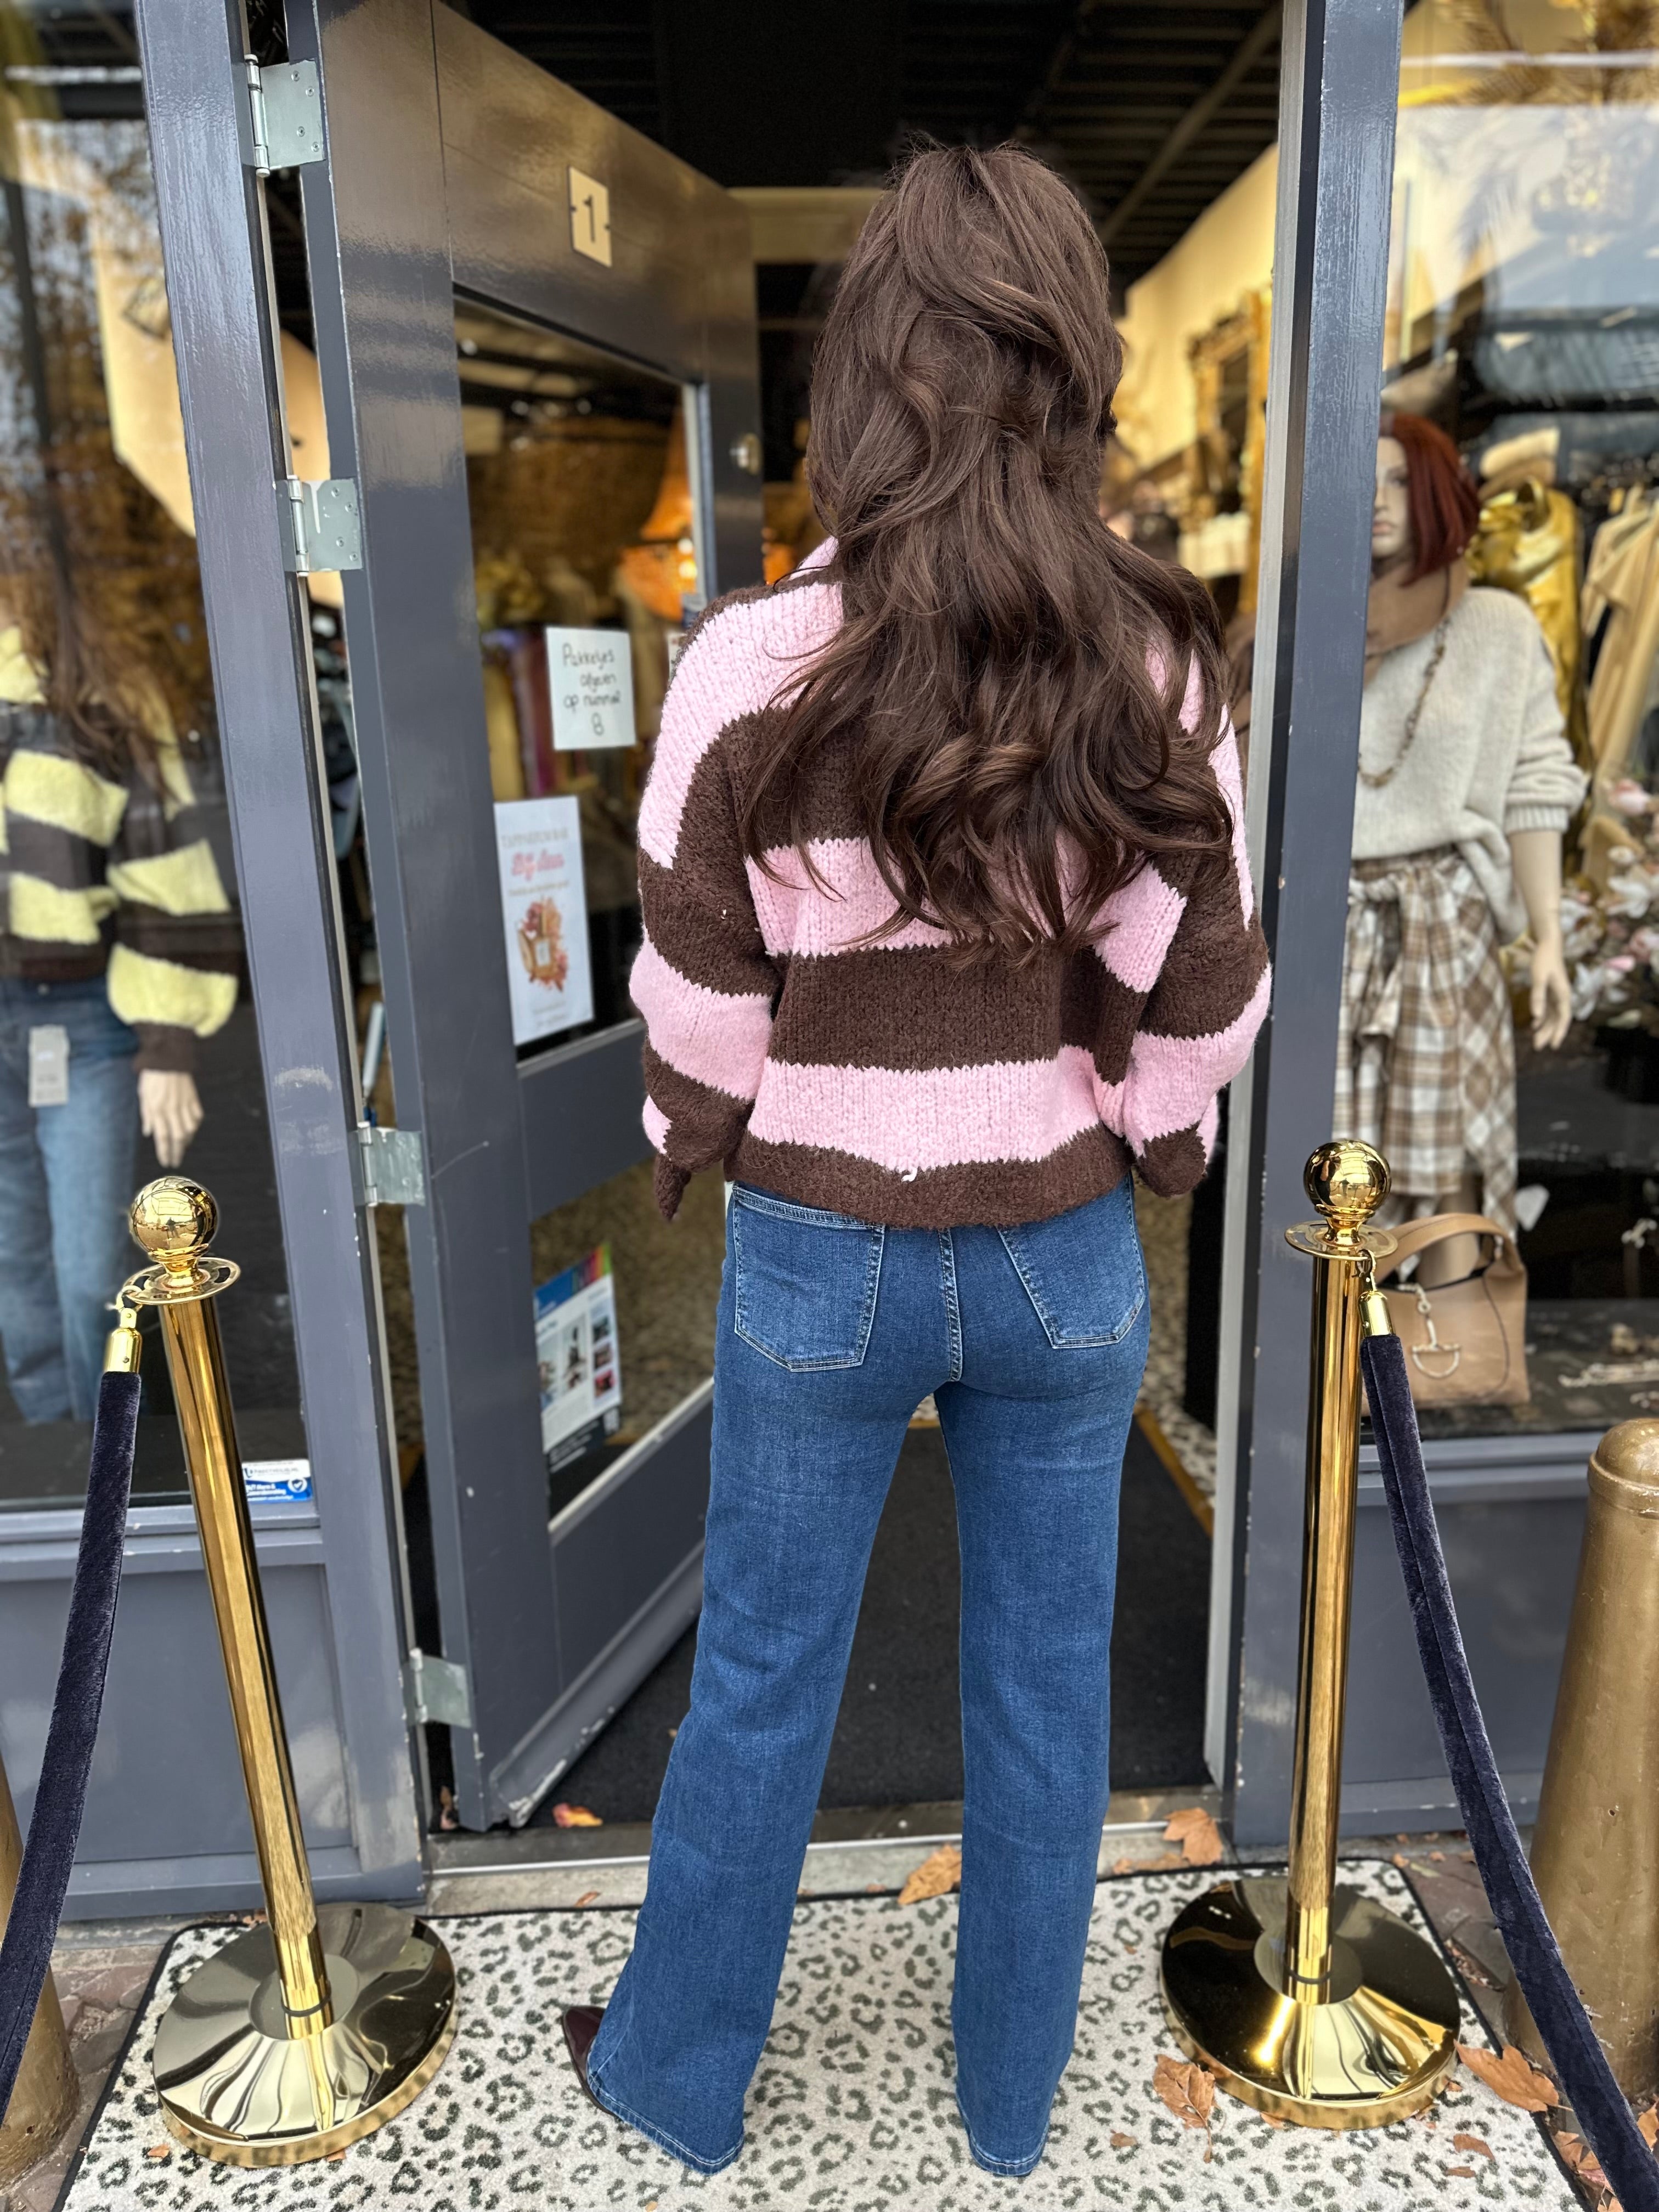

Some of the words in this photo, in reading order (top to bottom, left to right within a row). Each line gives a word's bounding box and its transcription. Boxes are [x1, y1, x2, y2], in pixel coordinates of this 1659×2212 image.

[583, 195, 595, 243] 1
[563, 694, 579, 713] op
[591, 712, 605, 736] 8
